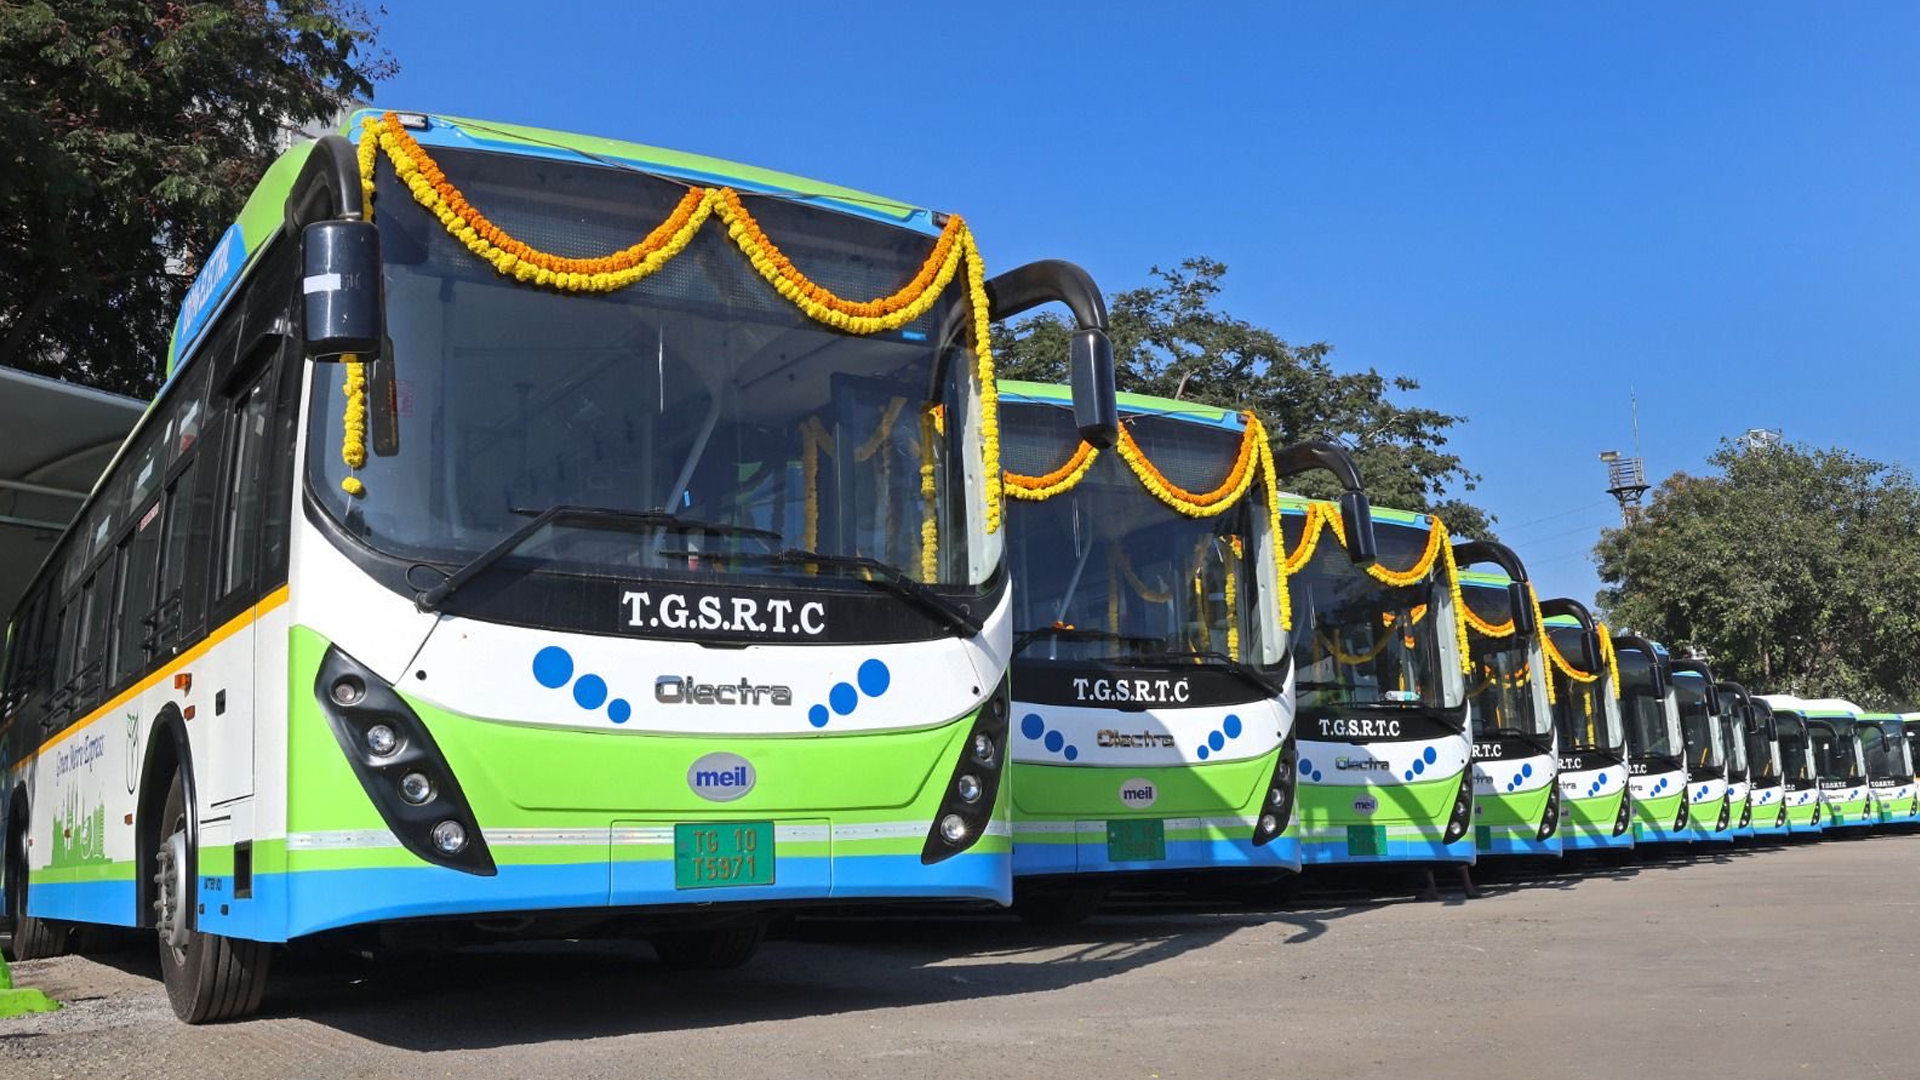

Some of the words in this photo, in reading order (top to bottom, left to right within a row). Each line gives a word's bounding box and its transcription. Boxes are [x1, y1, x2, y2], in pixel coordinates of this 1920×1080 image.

[622, 591, 825, 634] T.G.S.R.T.C
[655, 675, 793, 706] Olectra
[1073, 678, 1189, 702] T.G.S.R.T.C
[1096, 730, 1175, 748] Olectra
[1319, 719, 1400, 737] T.G.S.R.T.C
[696, 766, 746, 787] meil
[1123, 786, 1153, 800] meil
[693, 829, 719, 854] TG
[734, 826, 757, 852] 10
[692, 855, 756, 881] T5971
